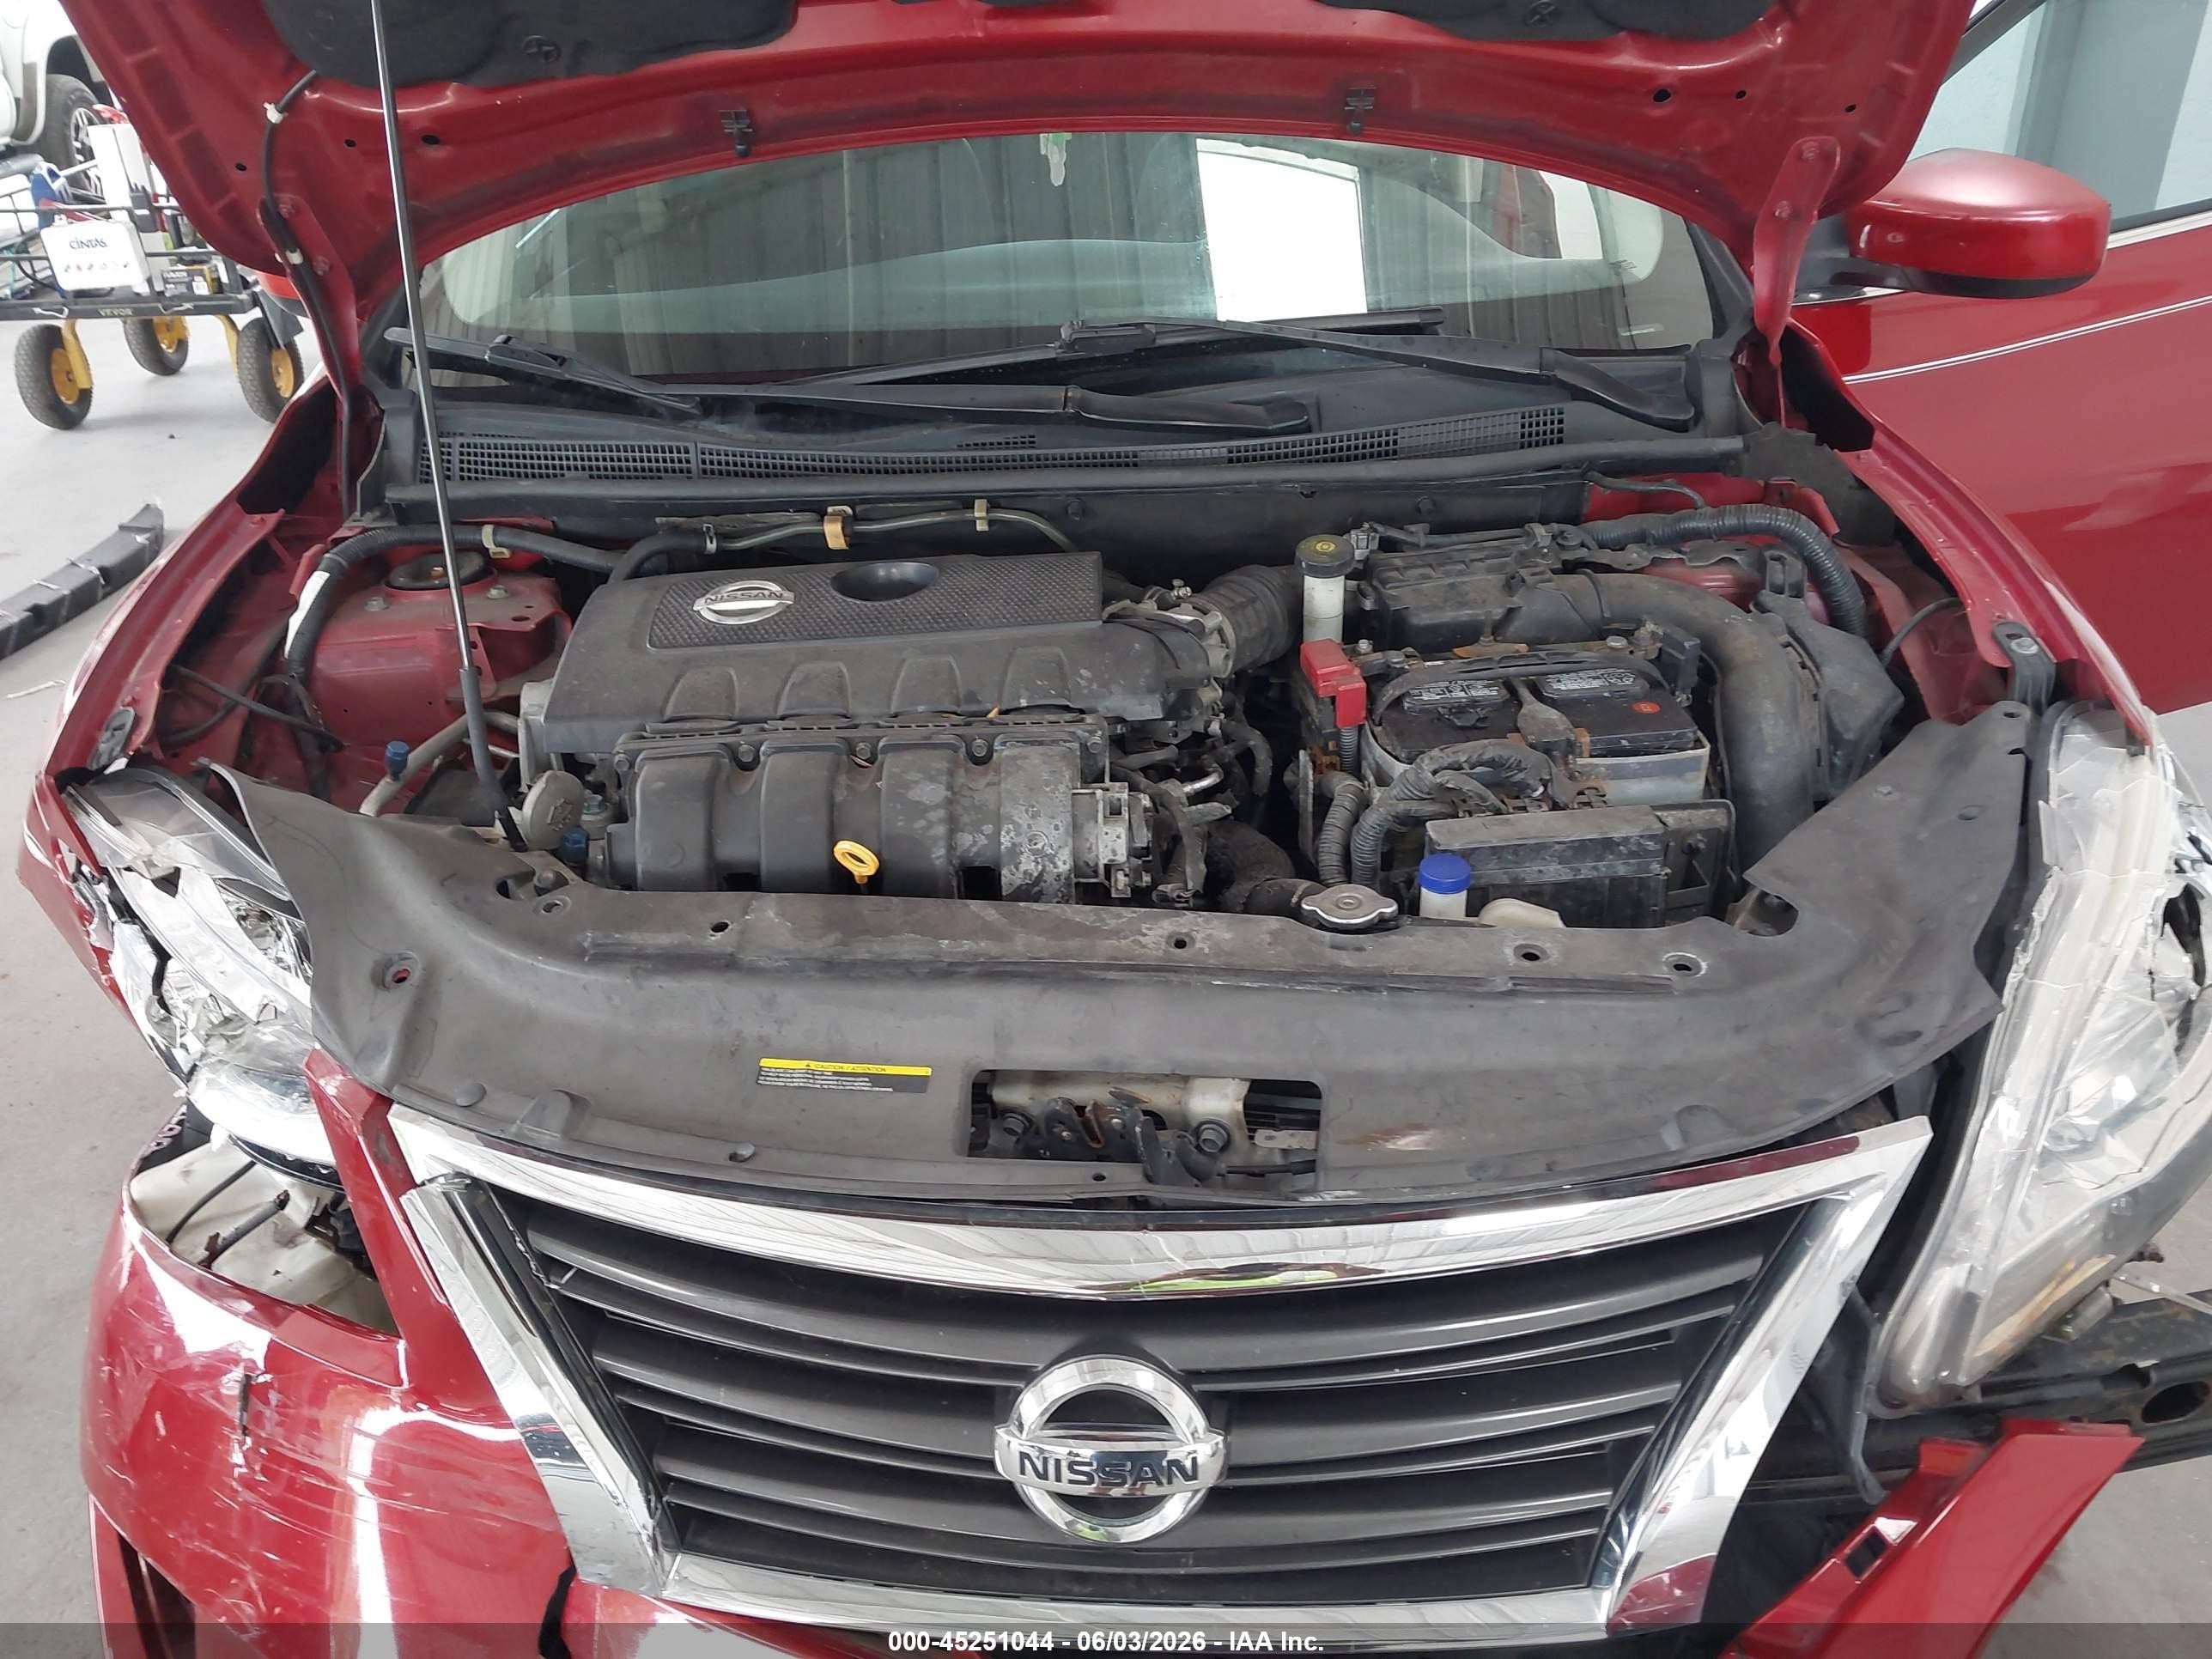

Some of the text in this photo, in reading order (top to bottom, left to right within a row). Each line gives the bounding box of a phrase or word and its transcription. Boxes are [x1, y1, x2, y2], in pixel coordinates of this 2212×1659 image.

[69, 237, 108, 250] CINTAS
[703, 591, 784, 605] NISSAN
[1018, 1450, 1199, 1488] NISSAN
